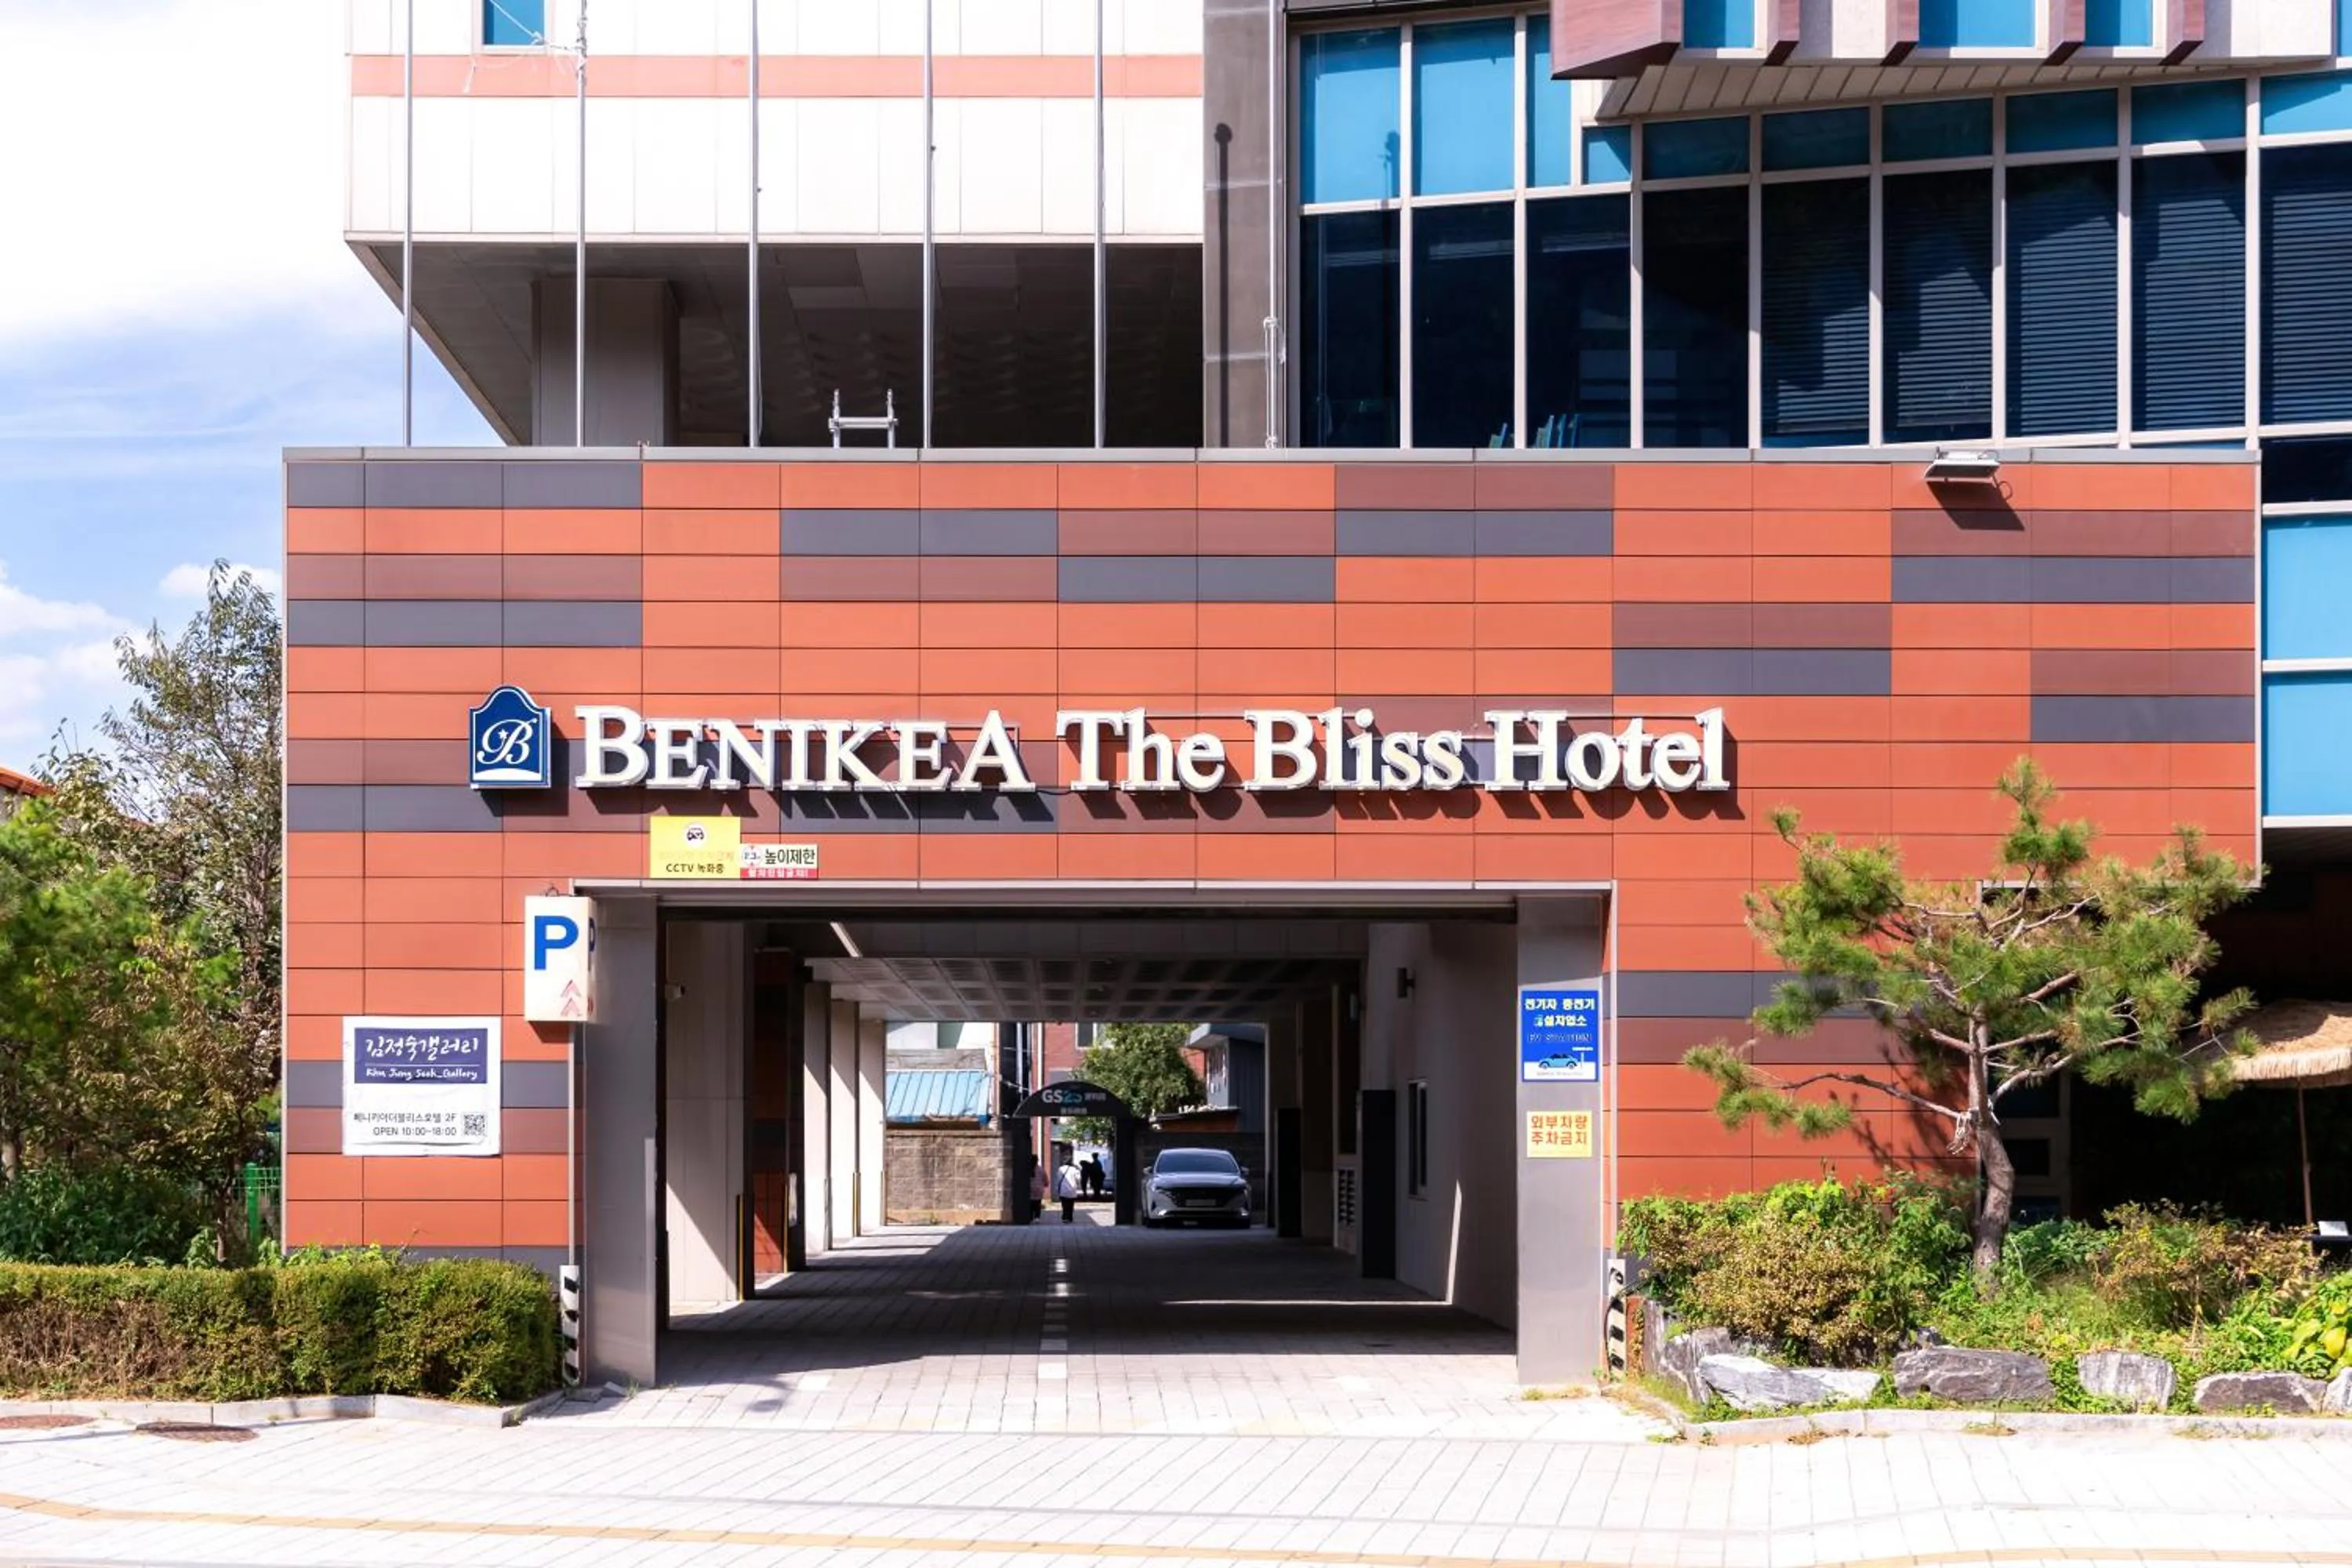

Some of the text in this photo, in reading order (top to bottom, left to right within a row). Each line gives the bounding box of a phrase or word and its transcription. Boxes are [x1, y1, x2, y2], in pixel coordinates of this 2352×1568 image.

[574, 705, 1730, 791] BENIKEA The Bliss Hotel
[765, 848, 815, 865] 높이제한
[666, 862, 724, 874] CCTV 녹화중
[535, 916, 579, 970] P
[365, 1035, 478, 1061] 김정숙갤러리
[366, 1067, 386, 1077] Kim
[1042, 1089, 1083, 1104] GS25
[445, 1112, 458, 1122] 2F
[1531, 1115, 1588, 1130] 외부차량
[372, 1127, 398, 1136] OPEN
[1531, 1131, 1588, 1145] 주차금지
